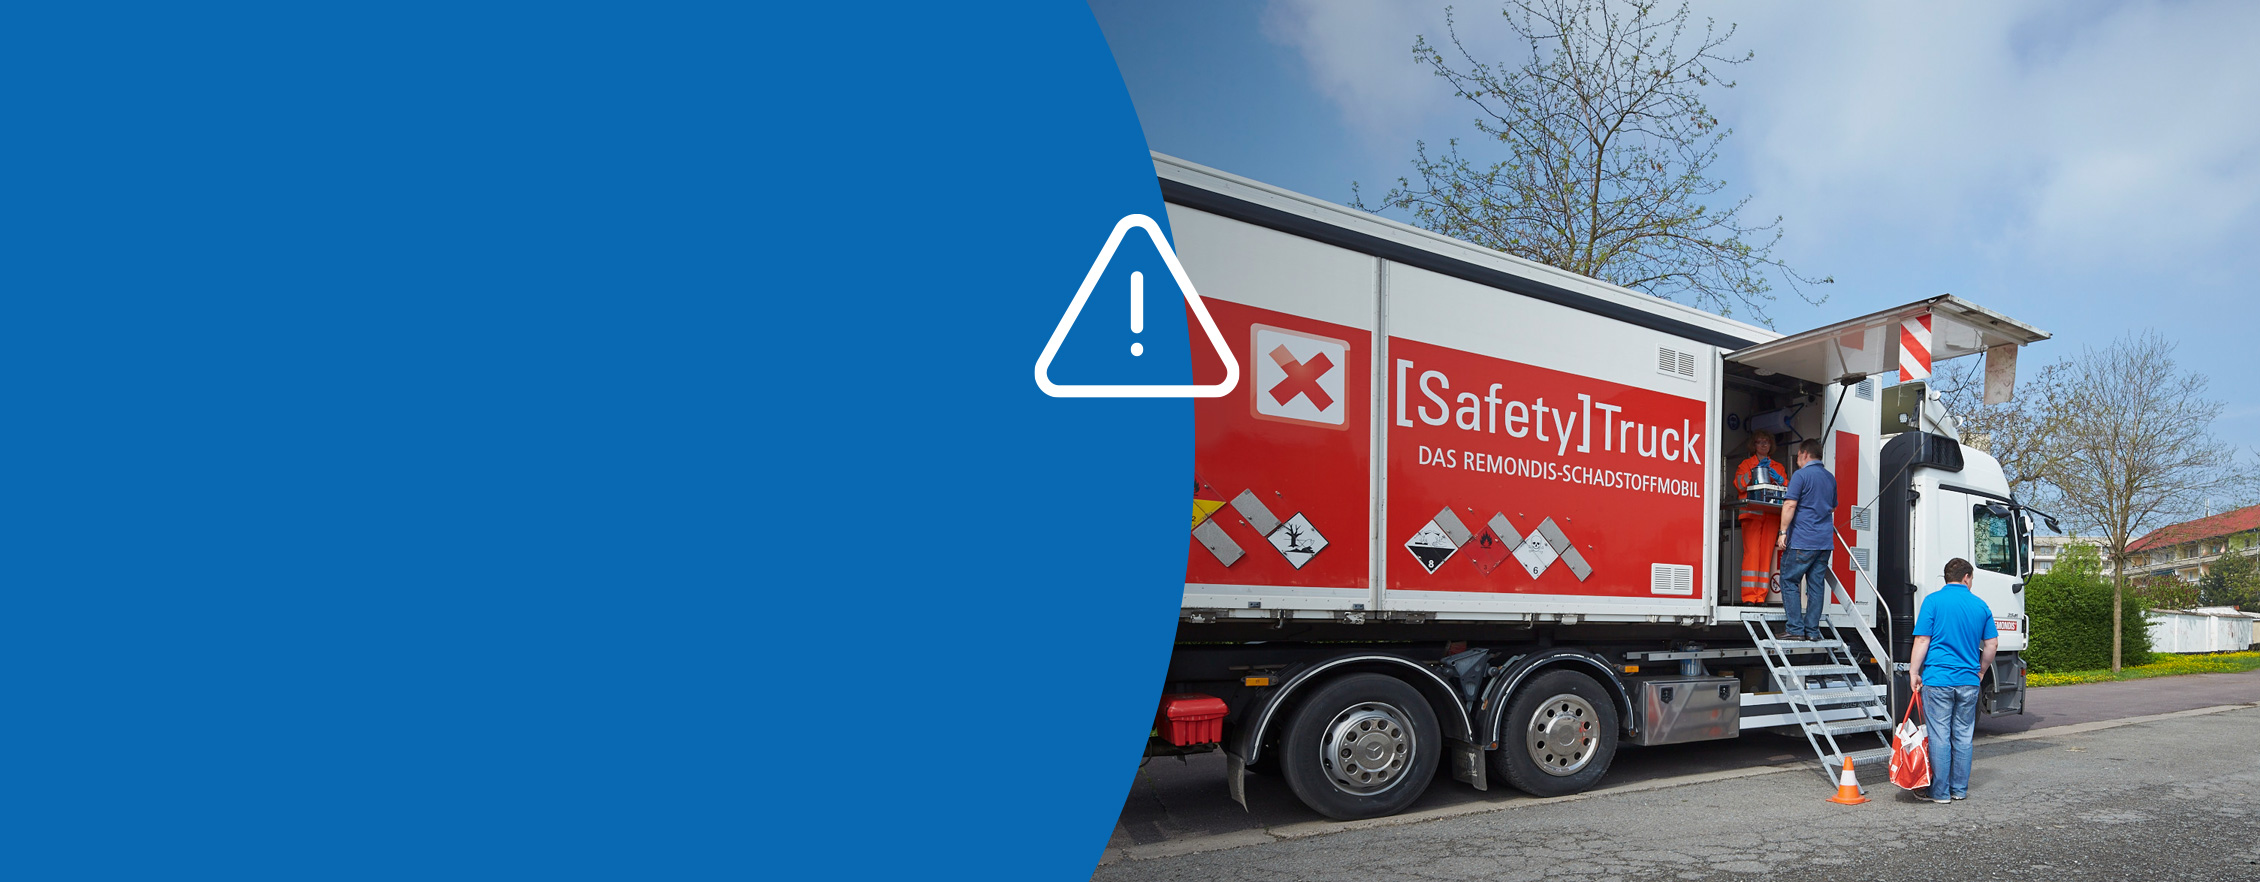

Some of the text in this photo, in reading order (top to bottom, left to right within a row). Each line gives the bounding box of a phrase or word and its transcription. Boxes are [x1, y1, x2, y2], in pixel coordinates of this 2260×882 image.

[1396, 358, 1702, 465] [Safety]Truck
[1418, 445, 1701, 498] DAS REMONDIS-SCHADSTOFFMOBIL
[1427, 559, 1435, 569] 8
[1532, 566, 1539, 575] 6
